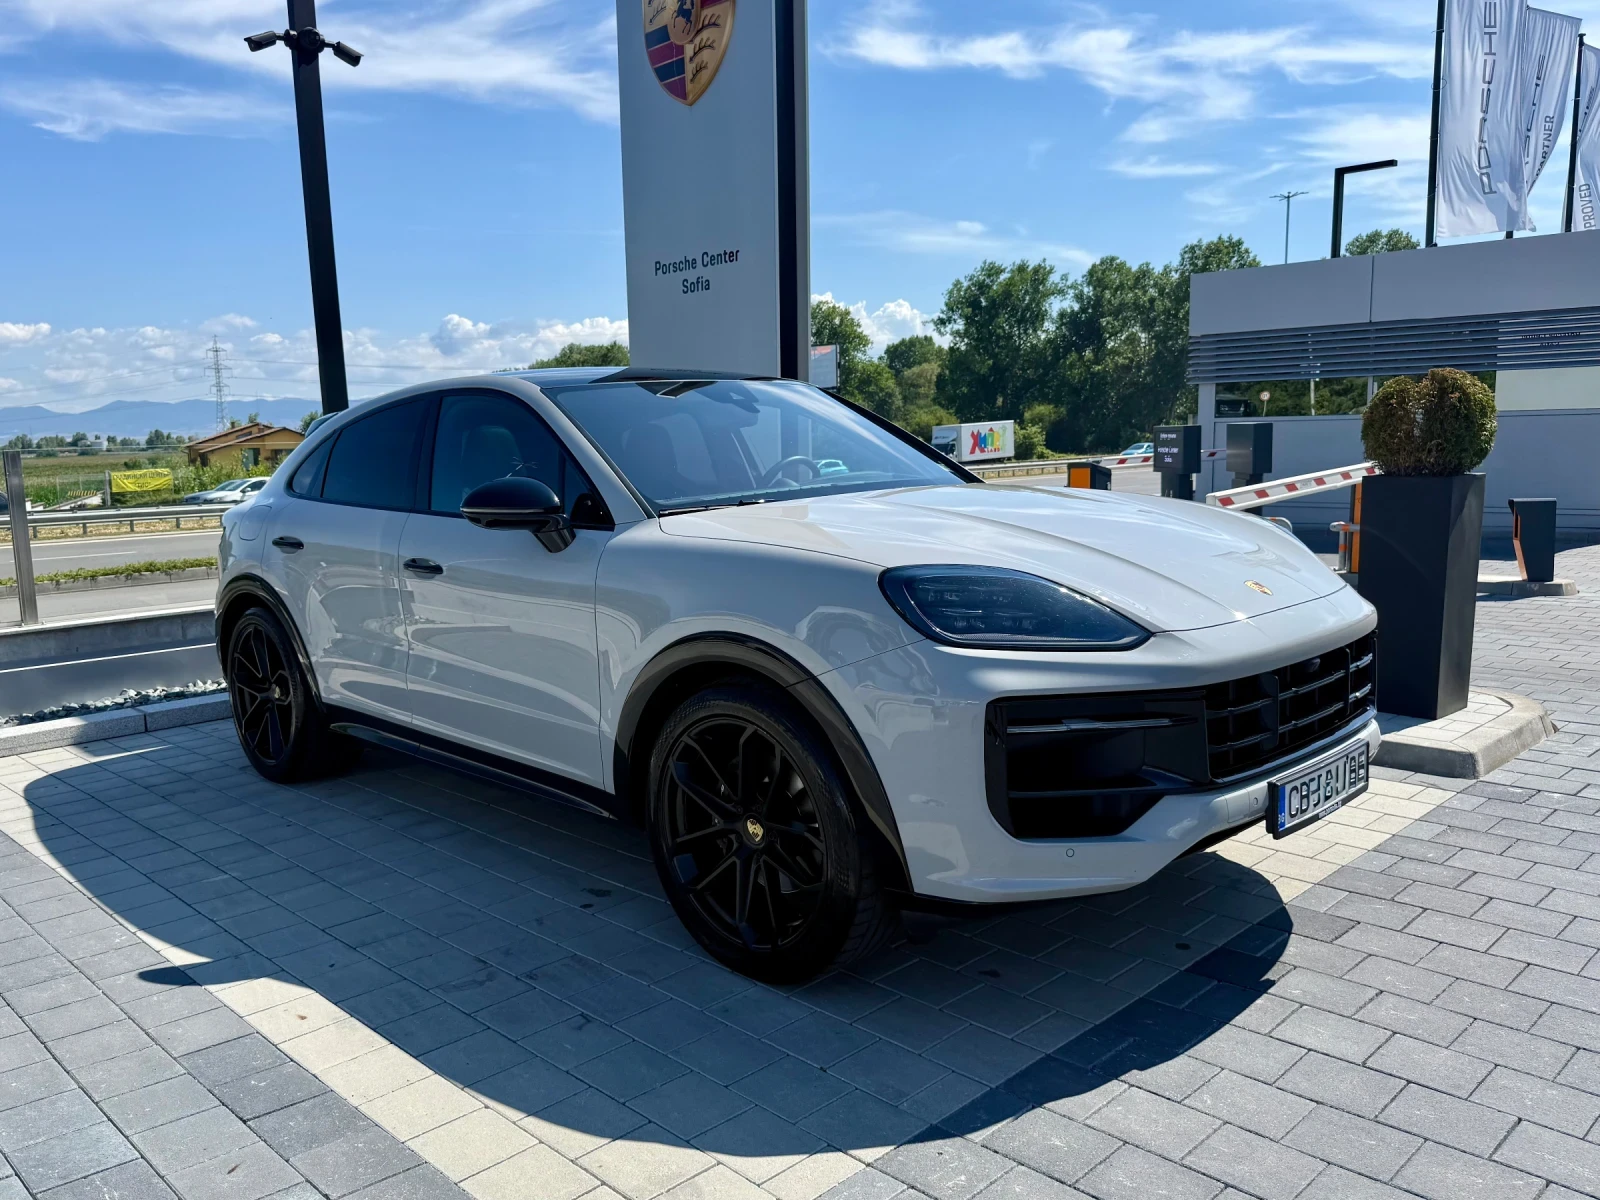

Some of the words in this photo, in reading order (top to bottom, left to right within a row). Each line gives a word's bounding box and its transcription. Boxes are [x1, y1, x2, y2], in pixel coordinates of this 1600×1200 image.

[1478, 1, 1497, 195] PORSCHE
[1535, 115, 1555, 177] PARTNER
[654, 255, 697, 276] Porsche
[701, 249, 740, 268] Center
[682, 276, 710, 294] Sofia
